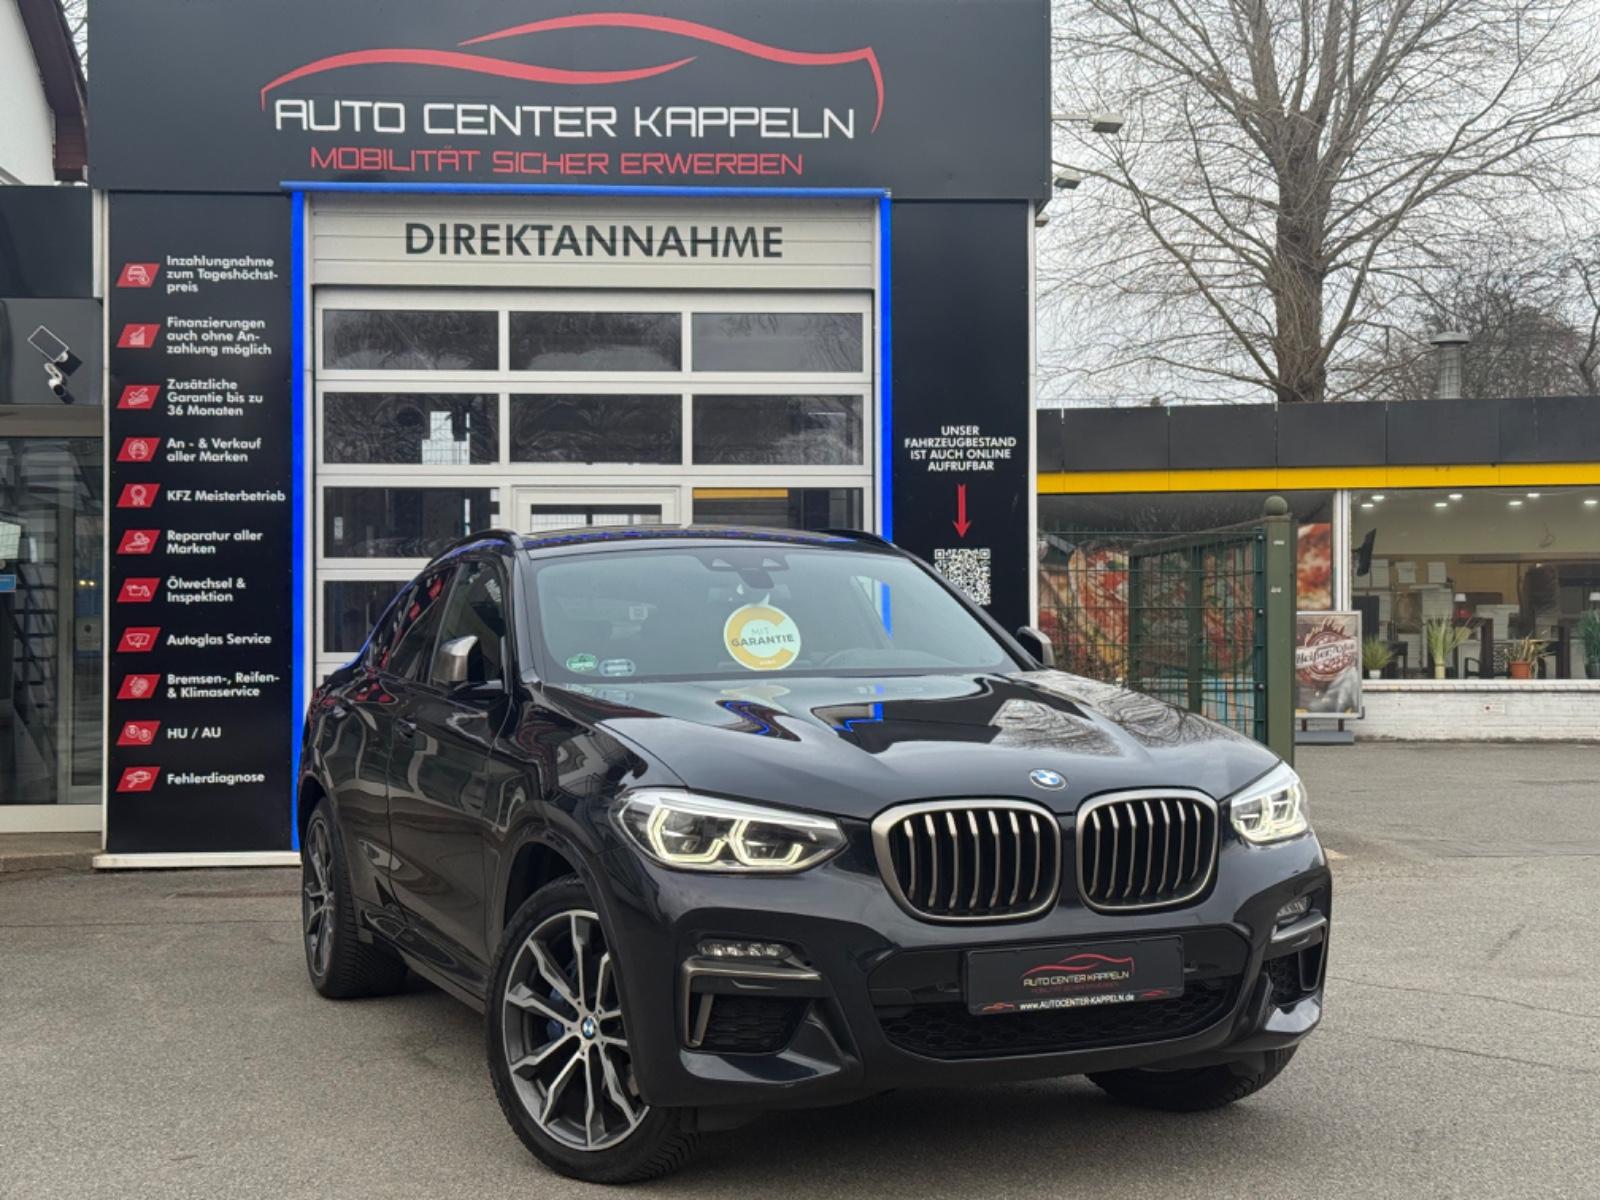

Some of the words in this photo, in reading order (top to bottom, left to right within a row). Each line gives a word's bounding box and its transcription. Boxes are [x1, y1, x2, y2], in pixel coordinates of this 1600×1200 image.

[275, 100, 406, 134] AUTO
[423, 103, 616, 137] CENTER
[635, 107, 855, 139] KAPPELN
[310, 146, 481, 172] MOBILITÄT
[492, 151, 609, 174] SICHER
[621, 153, 803, 175] ERWERBEN
[405, 223, 783, 258] DIREKTANNAHME
[166, 255, 274, 268] Inzahlungnahme
[166, 270, 193, 279] zum
[198, 269, 278, 282] Tageshöchst-
[166, 282, 198, 294] preis
[166, 317, 265, 330] Finanzierungen
[166, 331, 197, 341] auch
[202, 331, 233, 341] ohne
[237, 331, 260, 341] An-
[166, 344, 218, 357] zahlung
[222, 344, 272, 357] möglich
[166, 379, 238, 390] Zusätzliche
[166, 392, 223, 403] Garantie
[227, 392, 245, 402] bis
[249, 394, 263, 403] zu
[167, 406, 183, 416] 36
[187, 405, 243, 416] Monaten
[941, 425, 979, 435] UNSER
[166, 438, 185, 449] An
[198, 438, 208, 449] &
[211, 438, 262, 449] Verkauf
[904, 437, 1016, 448] FAHRZEUGBESTAND
[166, 451, 196, 462] aller
[200, 451, 248, 462] Marken
[910, 450, 926, 460] IST
[930, 449, 964, 460] AUCH
[966, 449, 1011, 459] ONLINE
[928, 461, 994, 471] AUFRUFBAR
[166, 491, 192, 501] KFZ
[195, 490, 286, 501] Meisterbetrieb
[166, 530, 231, 542] Reparatur
[233, 530, 263, 541] aller
[166, 544, 216, 554] Marken
[166, 576, 232, 589] Ölwechsel
[236, 578, 246, 588] &
[166, 591, 233, 604] Inspektion
[166, 634, 222, 648] Autoglas
[227, 633, 271, 644] Service
[731, 634, 794, 647] GARANTIE
[167, 673, 231, 685] Bremsen-,
[236, 672, 280, 683] Reifen-
[167, 688, 177, 698] &
[181, 686, 260, 698] Klimaservice
[167, 728, 188, 739] HU
[202, 727, 221, 738] AU
[167, 772, 265, 785] Fehlerdiagnose
[1023, 976, 1050, 987] AUTO
[1050, 974, 1086, 985] CENTER
[1087, 970, 1129, 982] KAPPELN
[1020, 993, 1134, 1010] www.AUTOCENTER-KAPPELN.de
